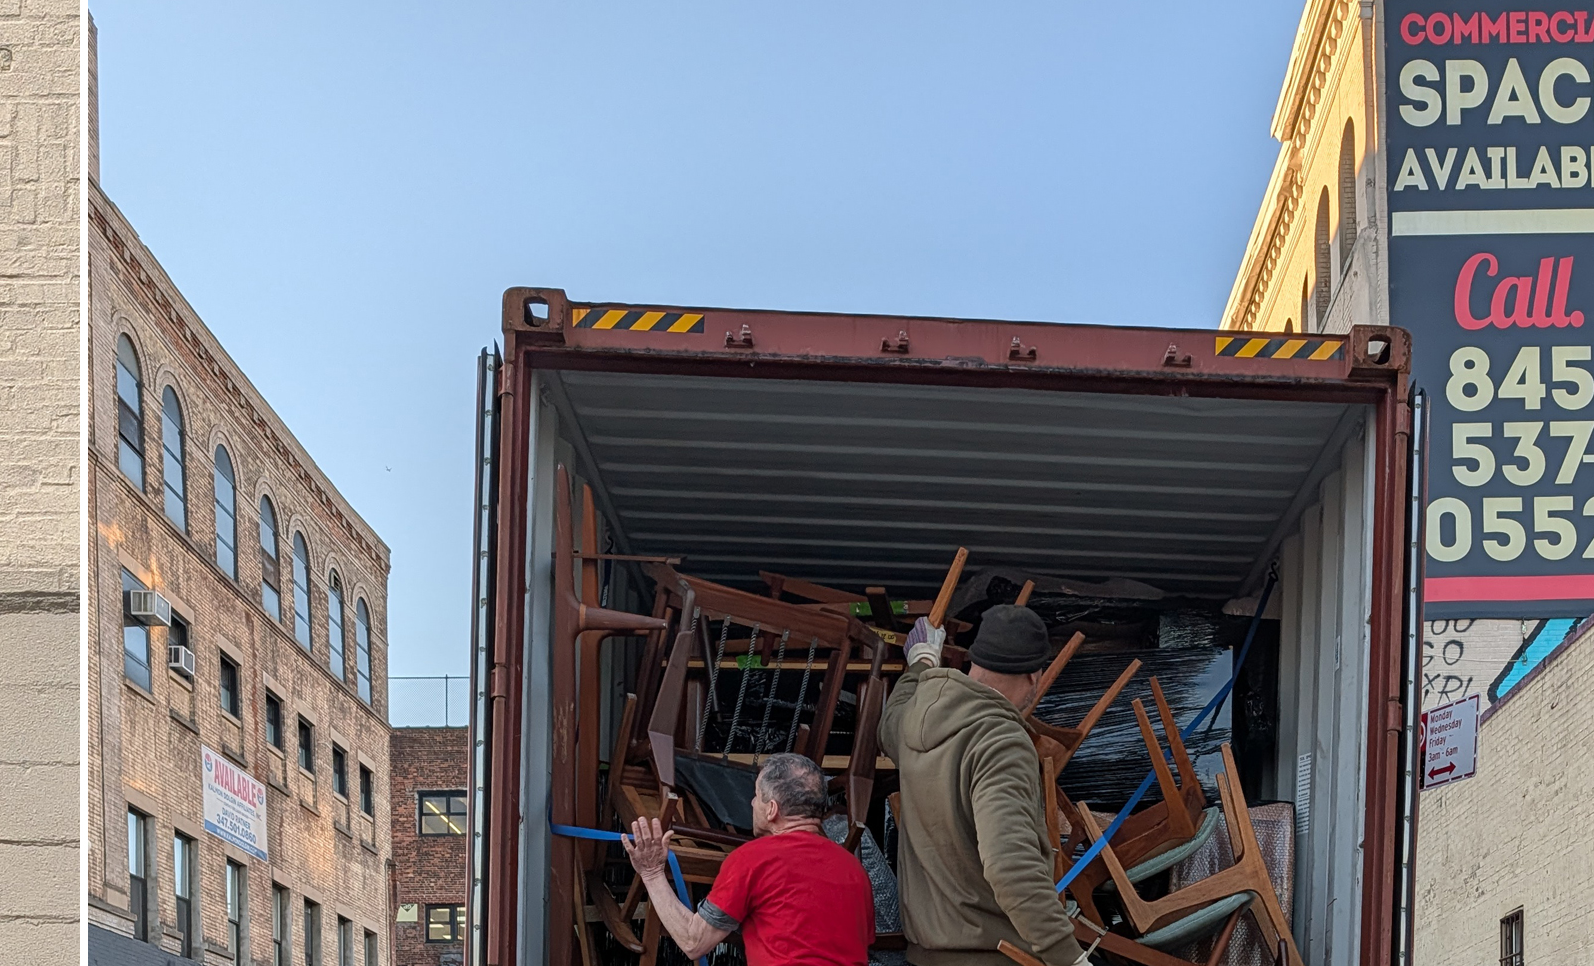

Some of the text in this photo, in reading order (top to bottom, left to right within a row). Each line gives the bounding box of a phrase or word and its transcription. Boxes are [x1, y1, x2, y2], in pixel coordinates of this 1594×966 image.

[1400, 11, 1594, 45] COMMERCI
[1399, 57, 1592, 127] SPAC
[1393, 145, 1594, 191] AVAILAB
[1454, 252, 1585, 330] Call.
[1445, 346, 1594, 412] 845
[1429, 719, 1463, 736] Wednesday
[1430, 710, 1453, 724] Monday
[1428, 752, 1441, 763] 3am
[1445, 746, 1459, 757] 6am
[1429, 736, 1447, 748] Friday
[214, 758, 257, 808] AVAILABLE
